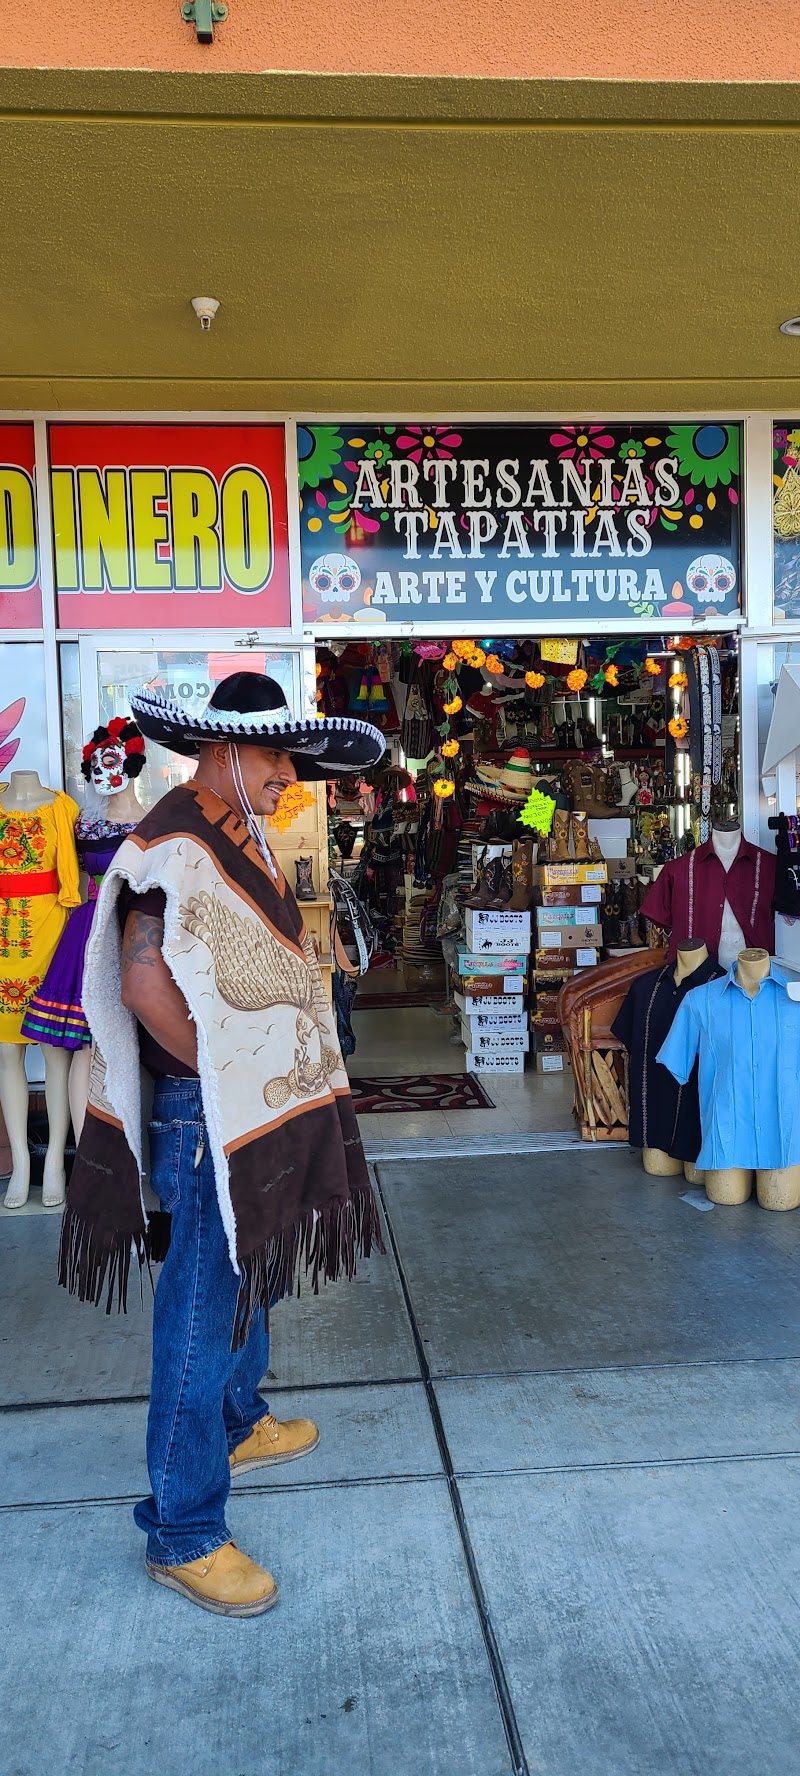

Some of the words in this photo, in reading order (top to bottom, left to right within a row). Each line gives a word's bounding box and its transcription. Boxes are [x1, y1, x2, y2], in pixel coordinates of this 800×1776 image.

[348, 456, 680, 509] ARTESANIAS
[394, 508, 653, 560] TAPATIAS
[371, 571, 468, 604] ARTE
[475, 570, 498, 602] Y
[506, 568, 668, 603] CULTURA
[499, 914, 524, 923] BOOTS
[493, 996, 516, 1005] BOOTS
[498, 1015, 522, 1024] BOOTS
[500, 1037, 524, 1046] BOOTS
[495, 1057, 519, 1066] BOOTS
